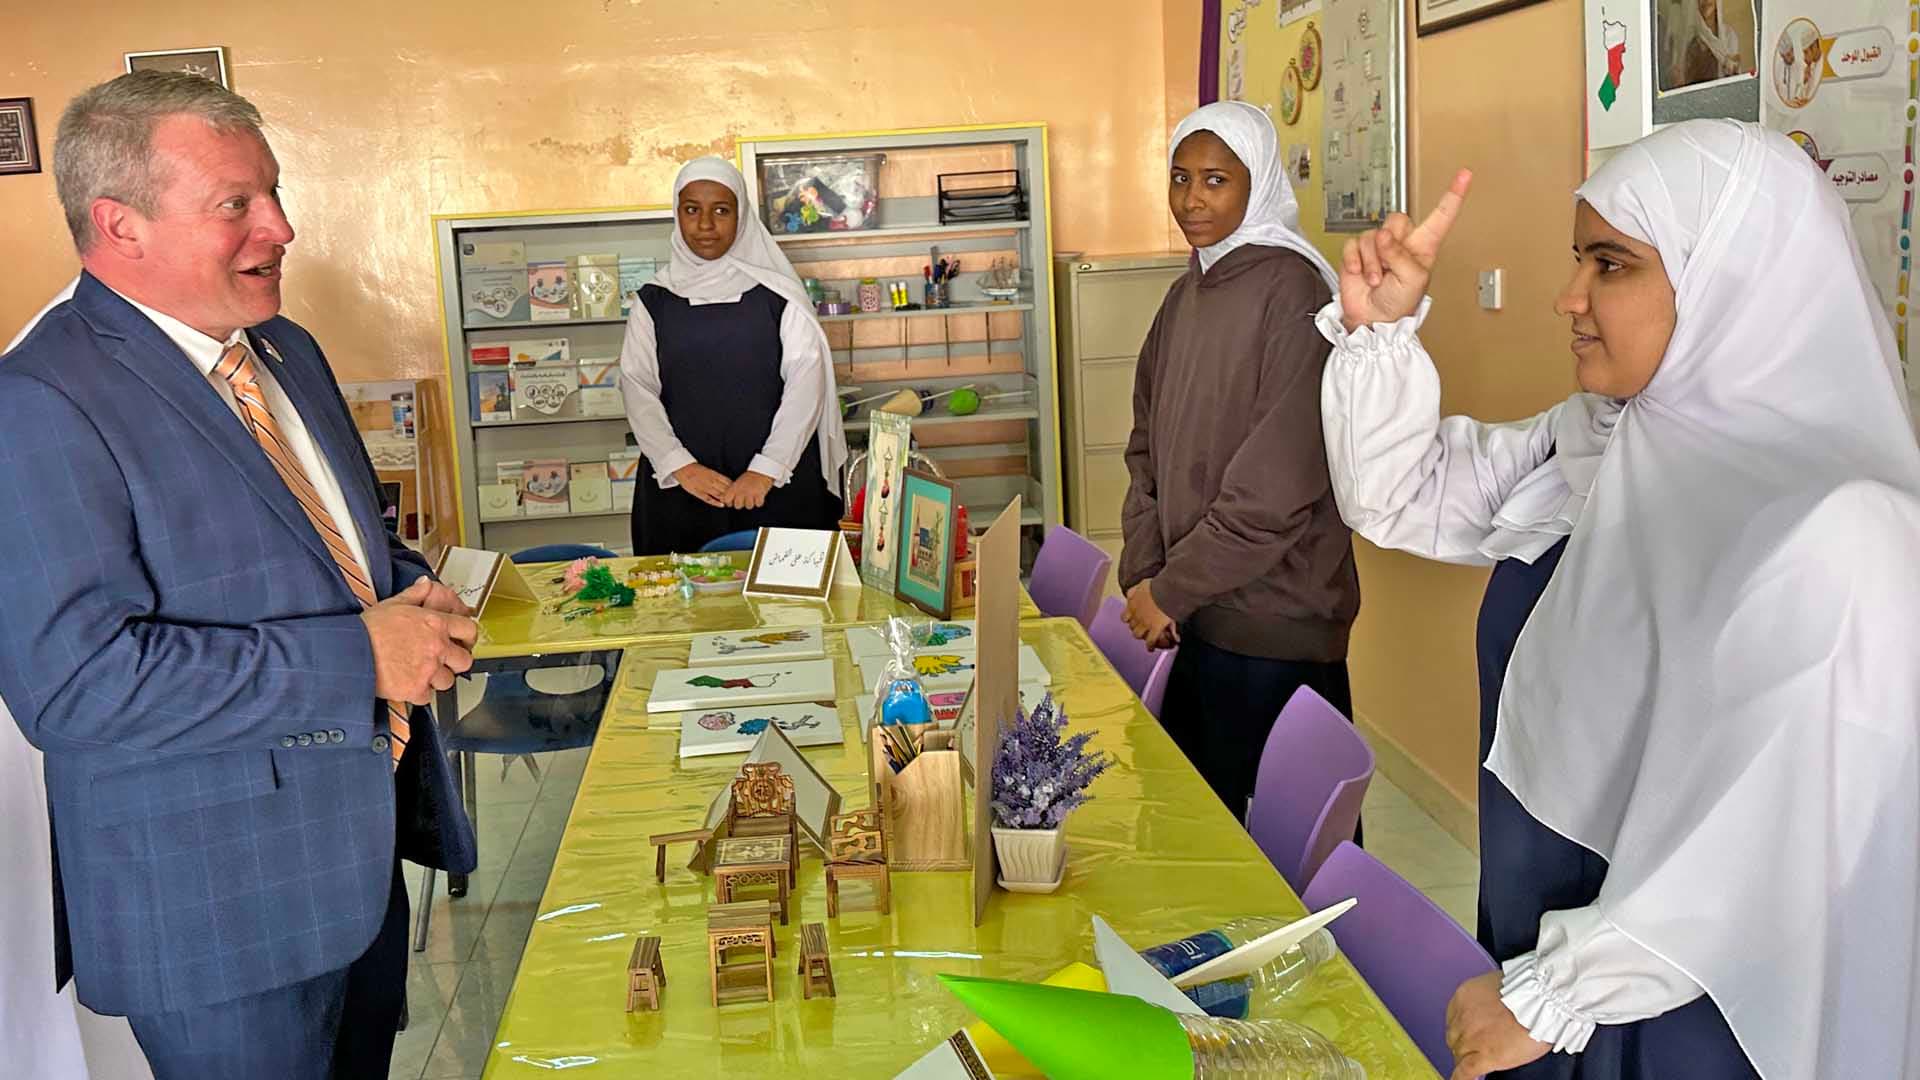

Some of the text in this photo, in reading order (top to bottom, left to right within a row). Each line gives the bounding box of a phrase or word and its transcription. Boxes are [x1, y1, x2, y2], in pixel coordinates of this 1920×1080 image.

[1860, 46, 1882, 62] القبول
[1832, 170, 1879, 186] مصادر التوجيه
